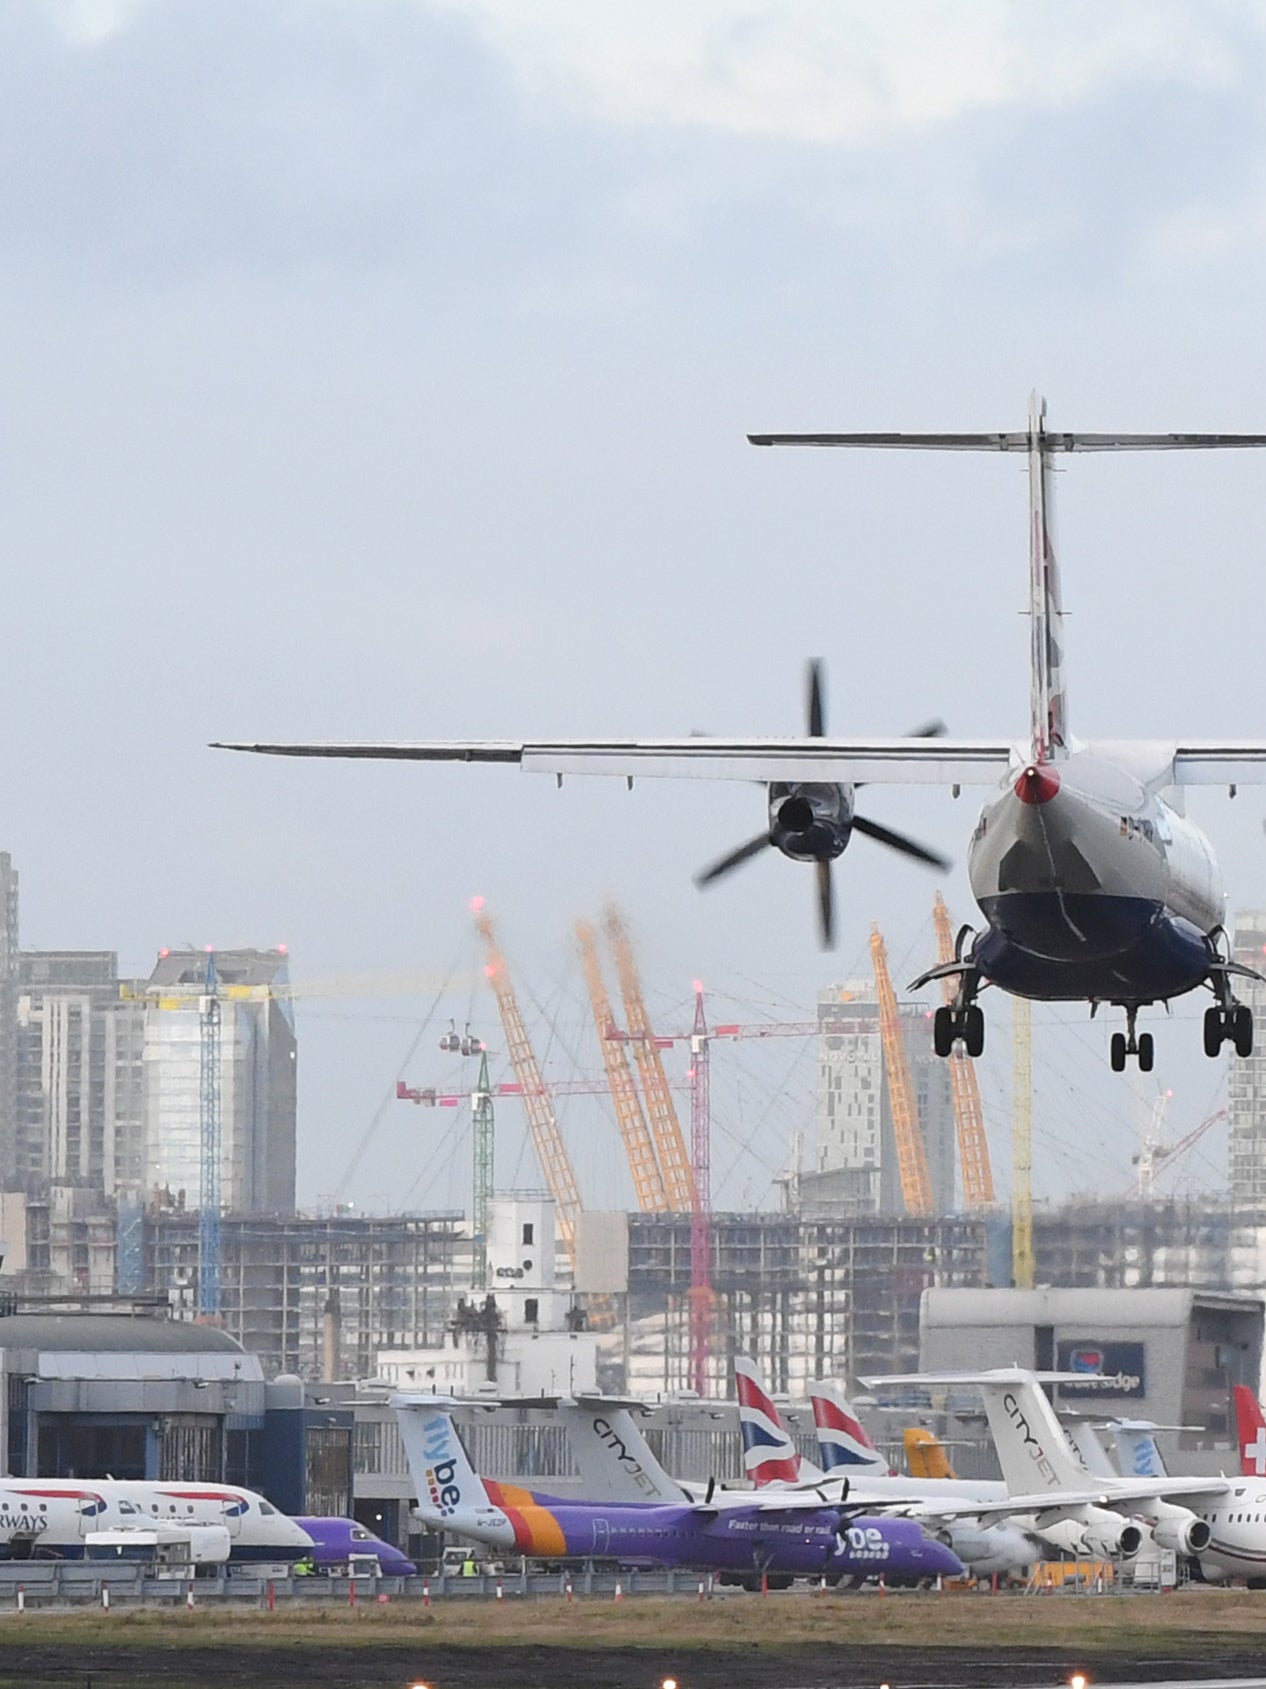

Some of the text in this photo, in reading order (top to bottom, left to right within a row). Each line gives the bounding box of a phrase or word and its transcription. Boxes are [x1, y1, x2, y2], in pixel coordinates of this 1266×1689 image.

[593, 1418, 662, 1497] CITYJET
[1003, 1394, 1061, 1485] CITYJET
[728, 1520, 832, 1534] Faster than road or rail
